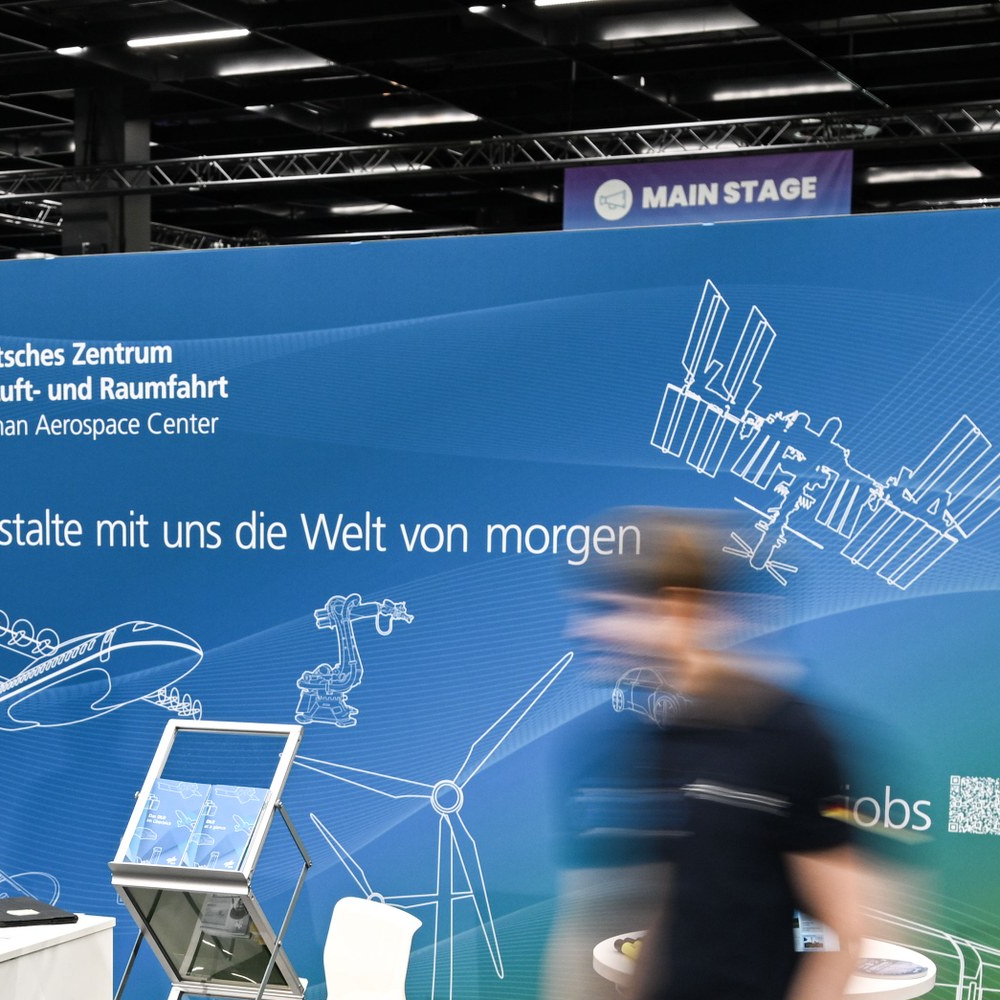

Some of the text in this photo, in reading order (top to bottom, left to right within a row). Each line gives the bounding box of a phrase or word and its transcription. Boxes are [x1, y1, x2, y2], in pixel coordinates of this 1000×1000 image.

[642, 176, 818, 209] MAIN STAGE
[72, 341, 173, 367] Zentrum
[47, 376, 93, 402] und
[100, 373, 229, 401] Raumfahrt
[35, 413, 140, 441] Aerospace
[147, 412, 219, 436] Center
[96, 510, 150, 549] mit
[163, 519, 222, 549] uns
[235, 510, 288, 551] die
[300, 511, 387, 552] Welt
[400, 522, 468, 553] von
[486, 522, 641, 566] morgen
